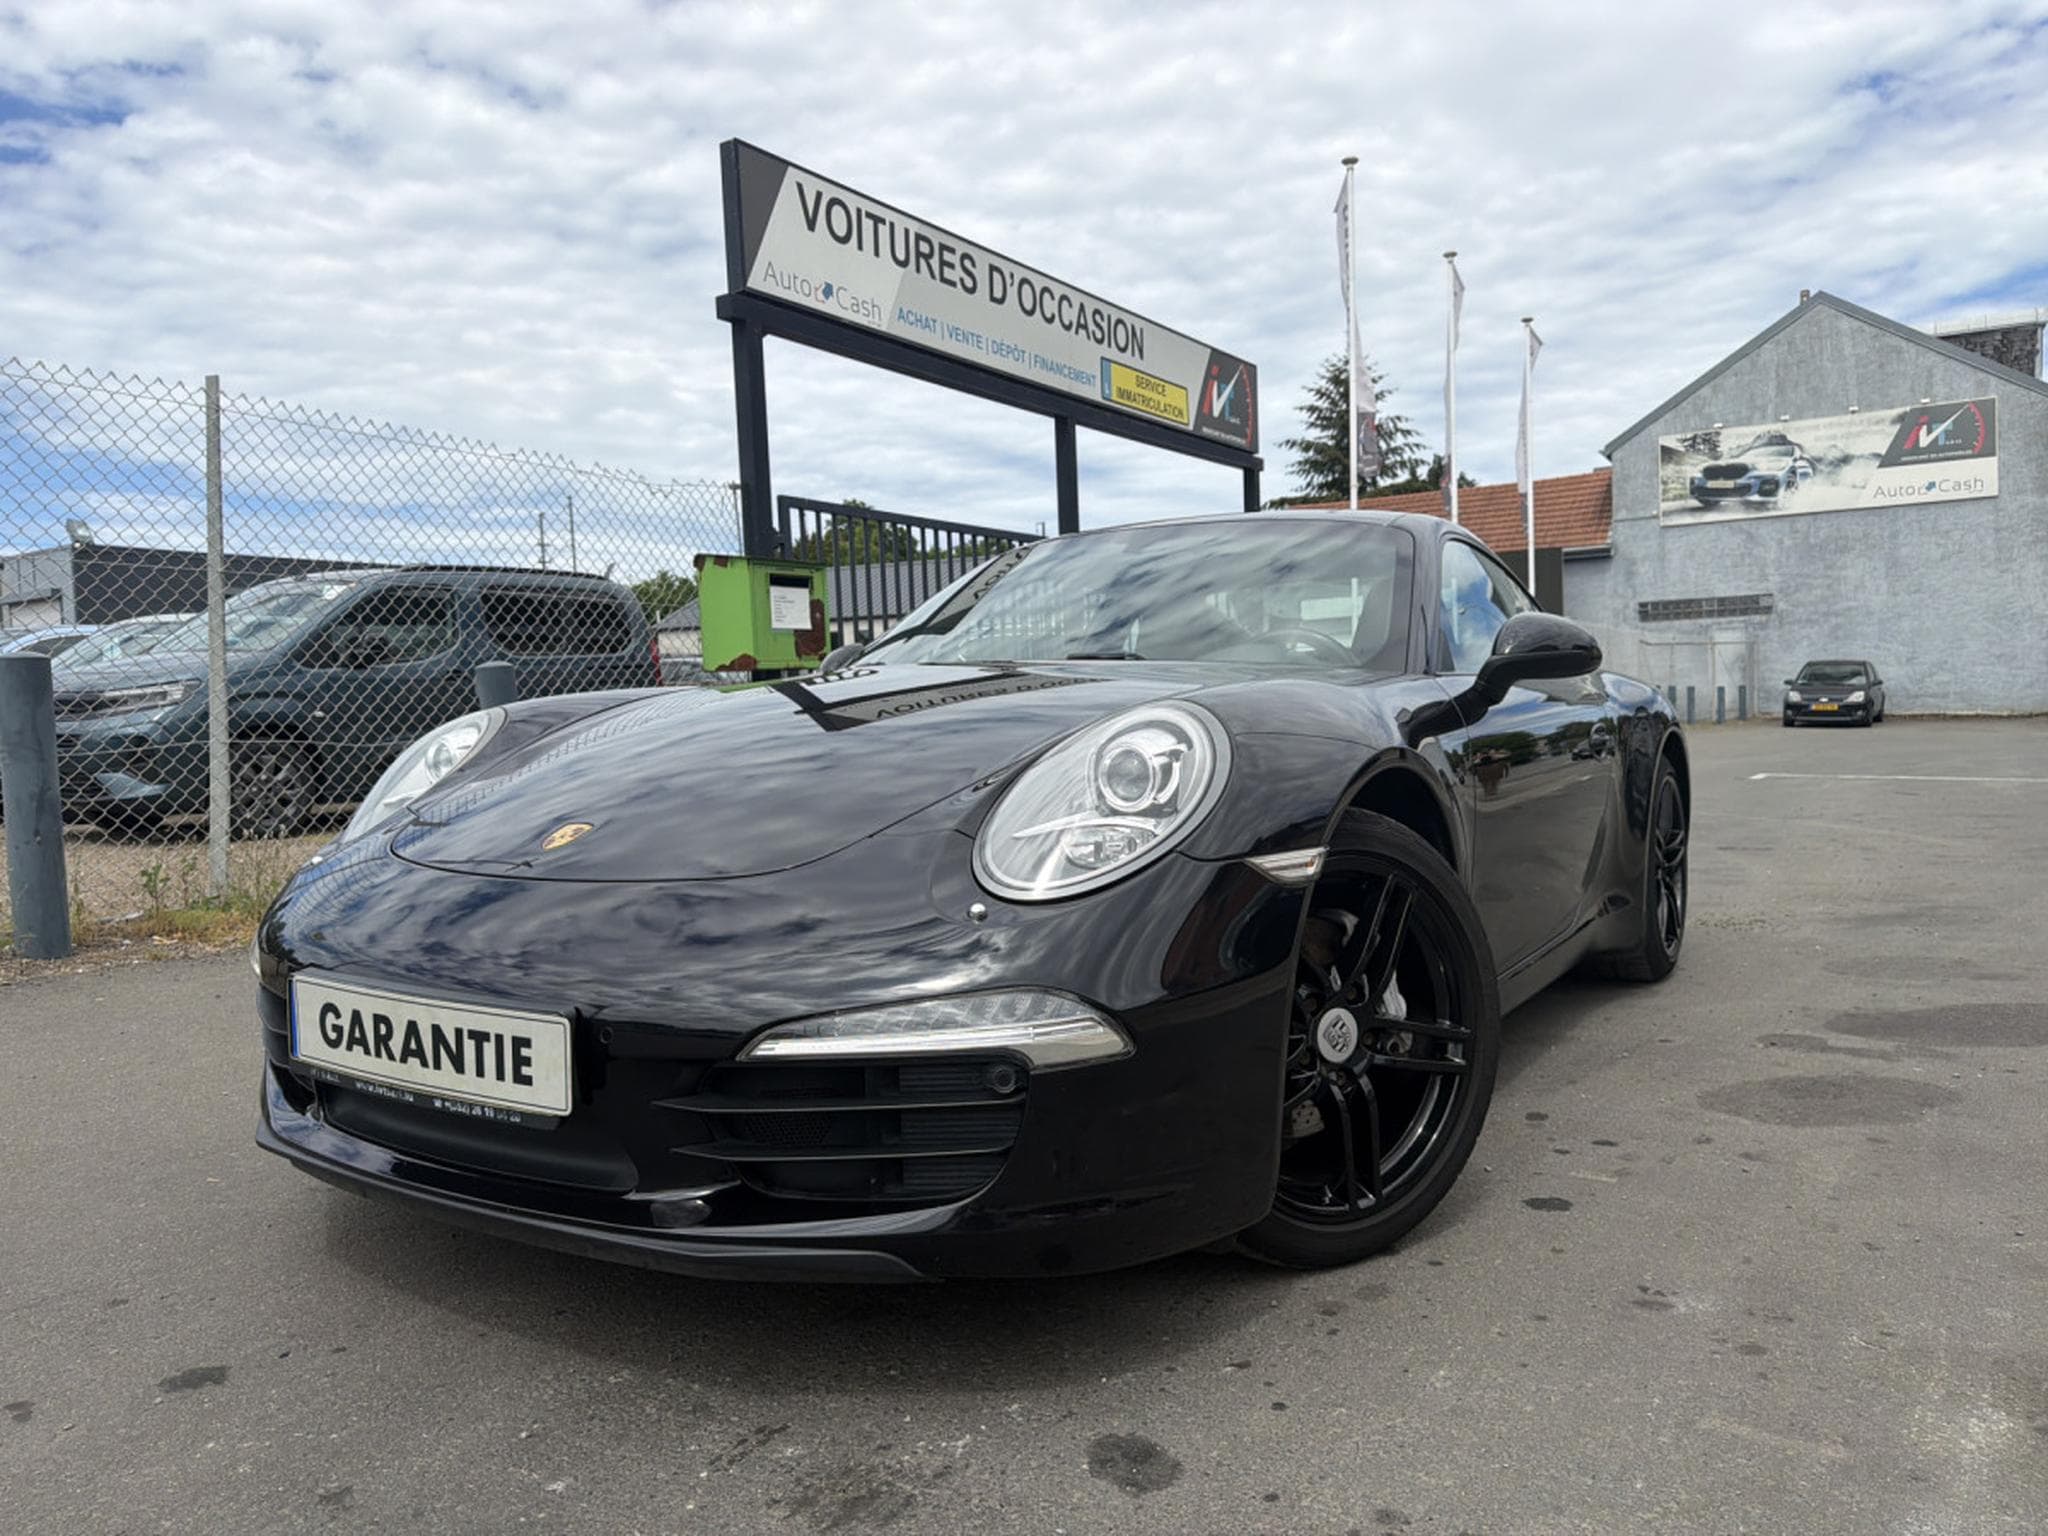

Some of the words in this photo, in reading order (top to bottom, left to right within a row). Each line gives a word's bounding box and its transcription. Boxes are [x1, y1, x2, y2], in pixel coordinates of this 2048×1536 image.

[763, 261, 812, 298] Auto
[835, 285, 882, 322] Cash
[795, 180, 979, 295] VOITURES
[988, 263, 1144, 361] D'OCCASION
[897, 307, 937, 334] ACHAT
[946, 324, 984, 350] VENTE
[991, 338, 1026, 364] DÉPÔT
[1033, 353, 1097, 387] FINANCEMENT
[1115, 386, 1185, 420] IMMATRICULATION
[1135, 374, 1168, 397] SERVICE
[1873, 483, 1918, 499] Auto
[1937, 476, 1985, 493] Cash
[319, 1002, 534, 1087] GARANTIE
